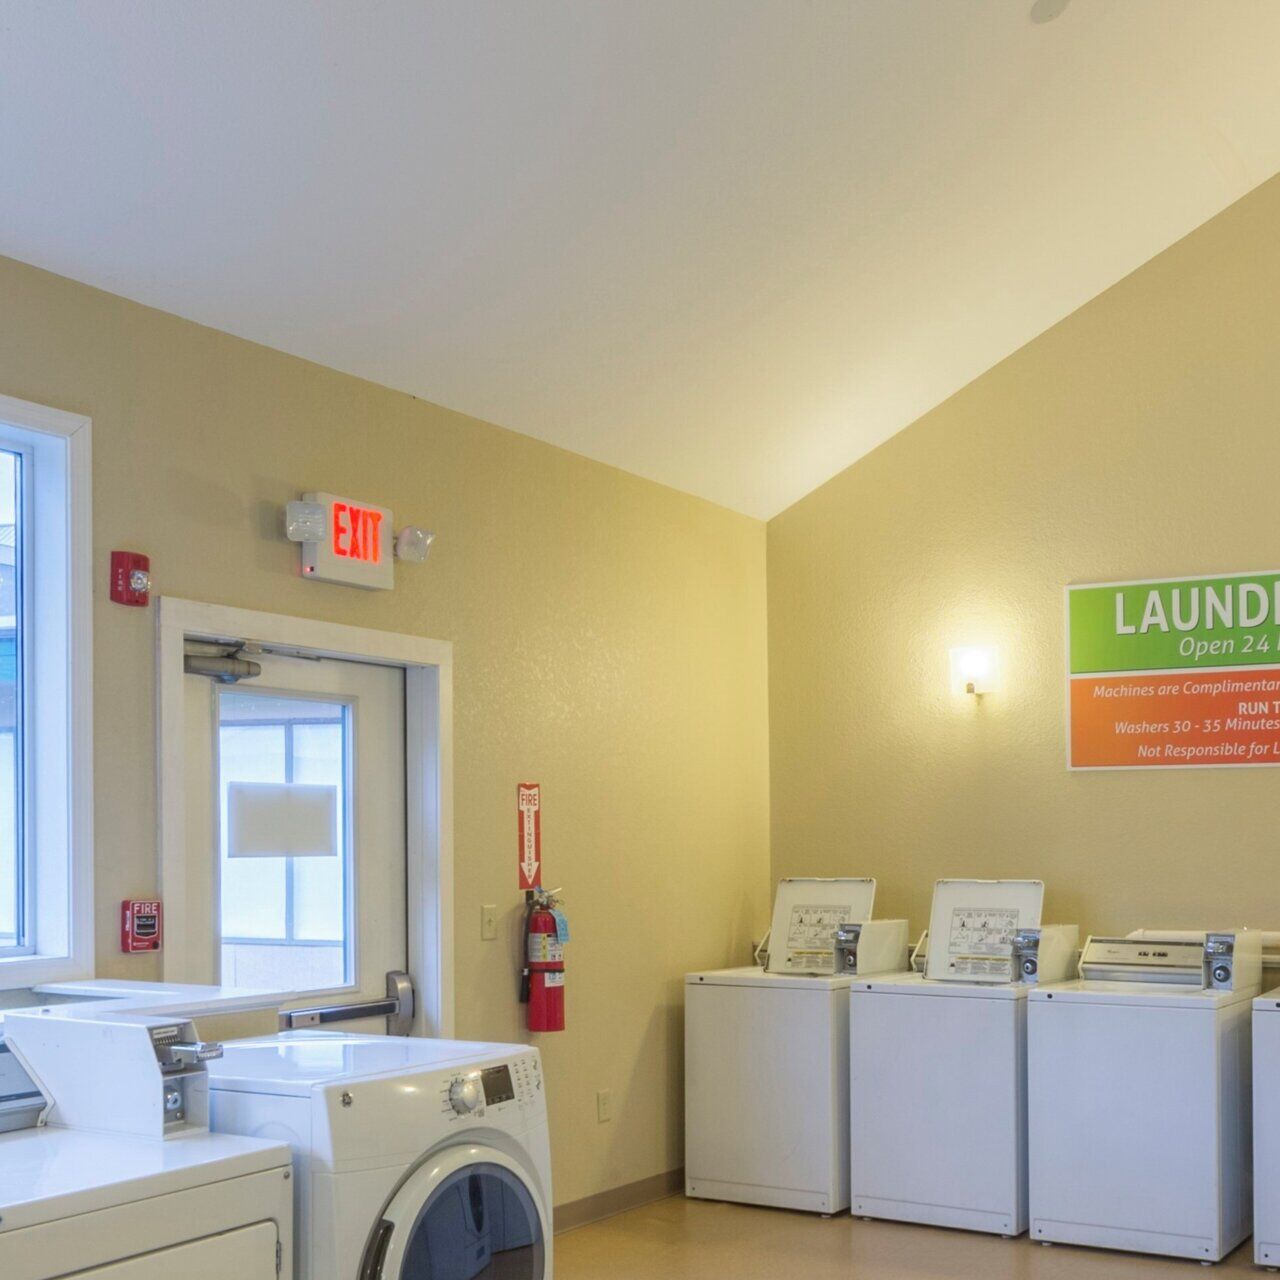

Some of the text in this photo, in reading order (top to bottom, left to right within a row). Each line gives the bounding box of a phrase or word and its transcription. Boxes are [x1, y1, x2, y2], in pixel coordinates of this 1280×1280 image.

[332, 501, 383, 564] EXIT
[1179, 636, 1235, 661] Open
[1240, 634, 1270, 654] 24
[1093, 684, 1155, 699] Machines
[1158, 685, 1180, 696] are
[1238, 701, 1269, 715] RUN
[1114, 720, 1170, 735] Washers
[1172, 720, 1192, 734] 30
[1202, 718, 1221, 733] 35
[1224, 717, 1280, 731] Minutes
[1137, 744, 1162, 757] Not
[1164, 742, 1246, 760] Responsible
[1248, 741, 1270, 758] for
[520, 793, 538, 807] FIRE
[133, 903, 158, 914] FIRE
